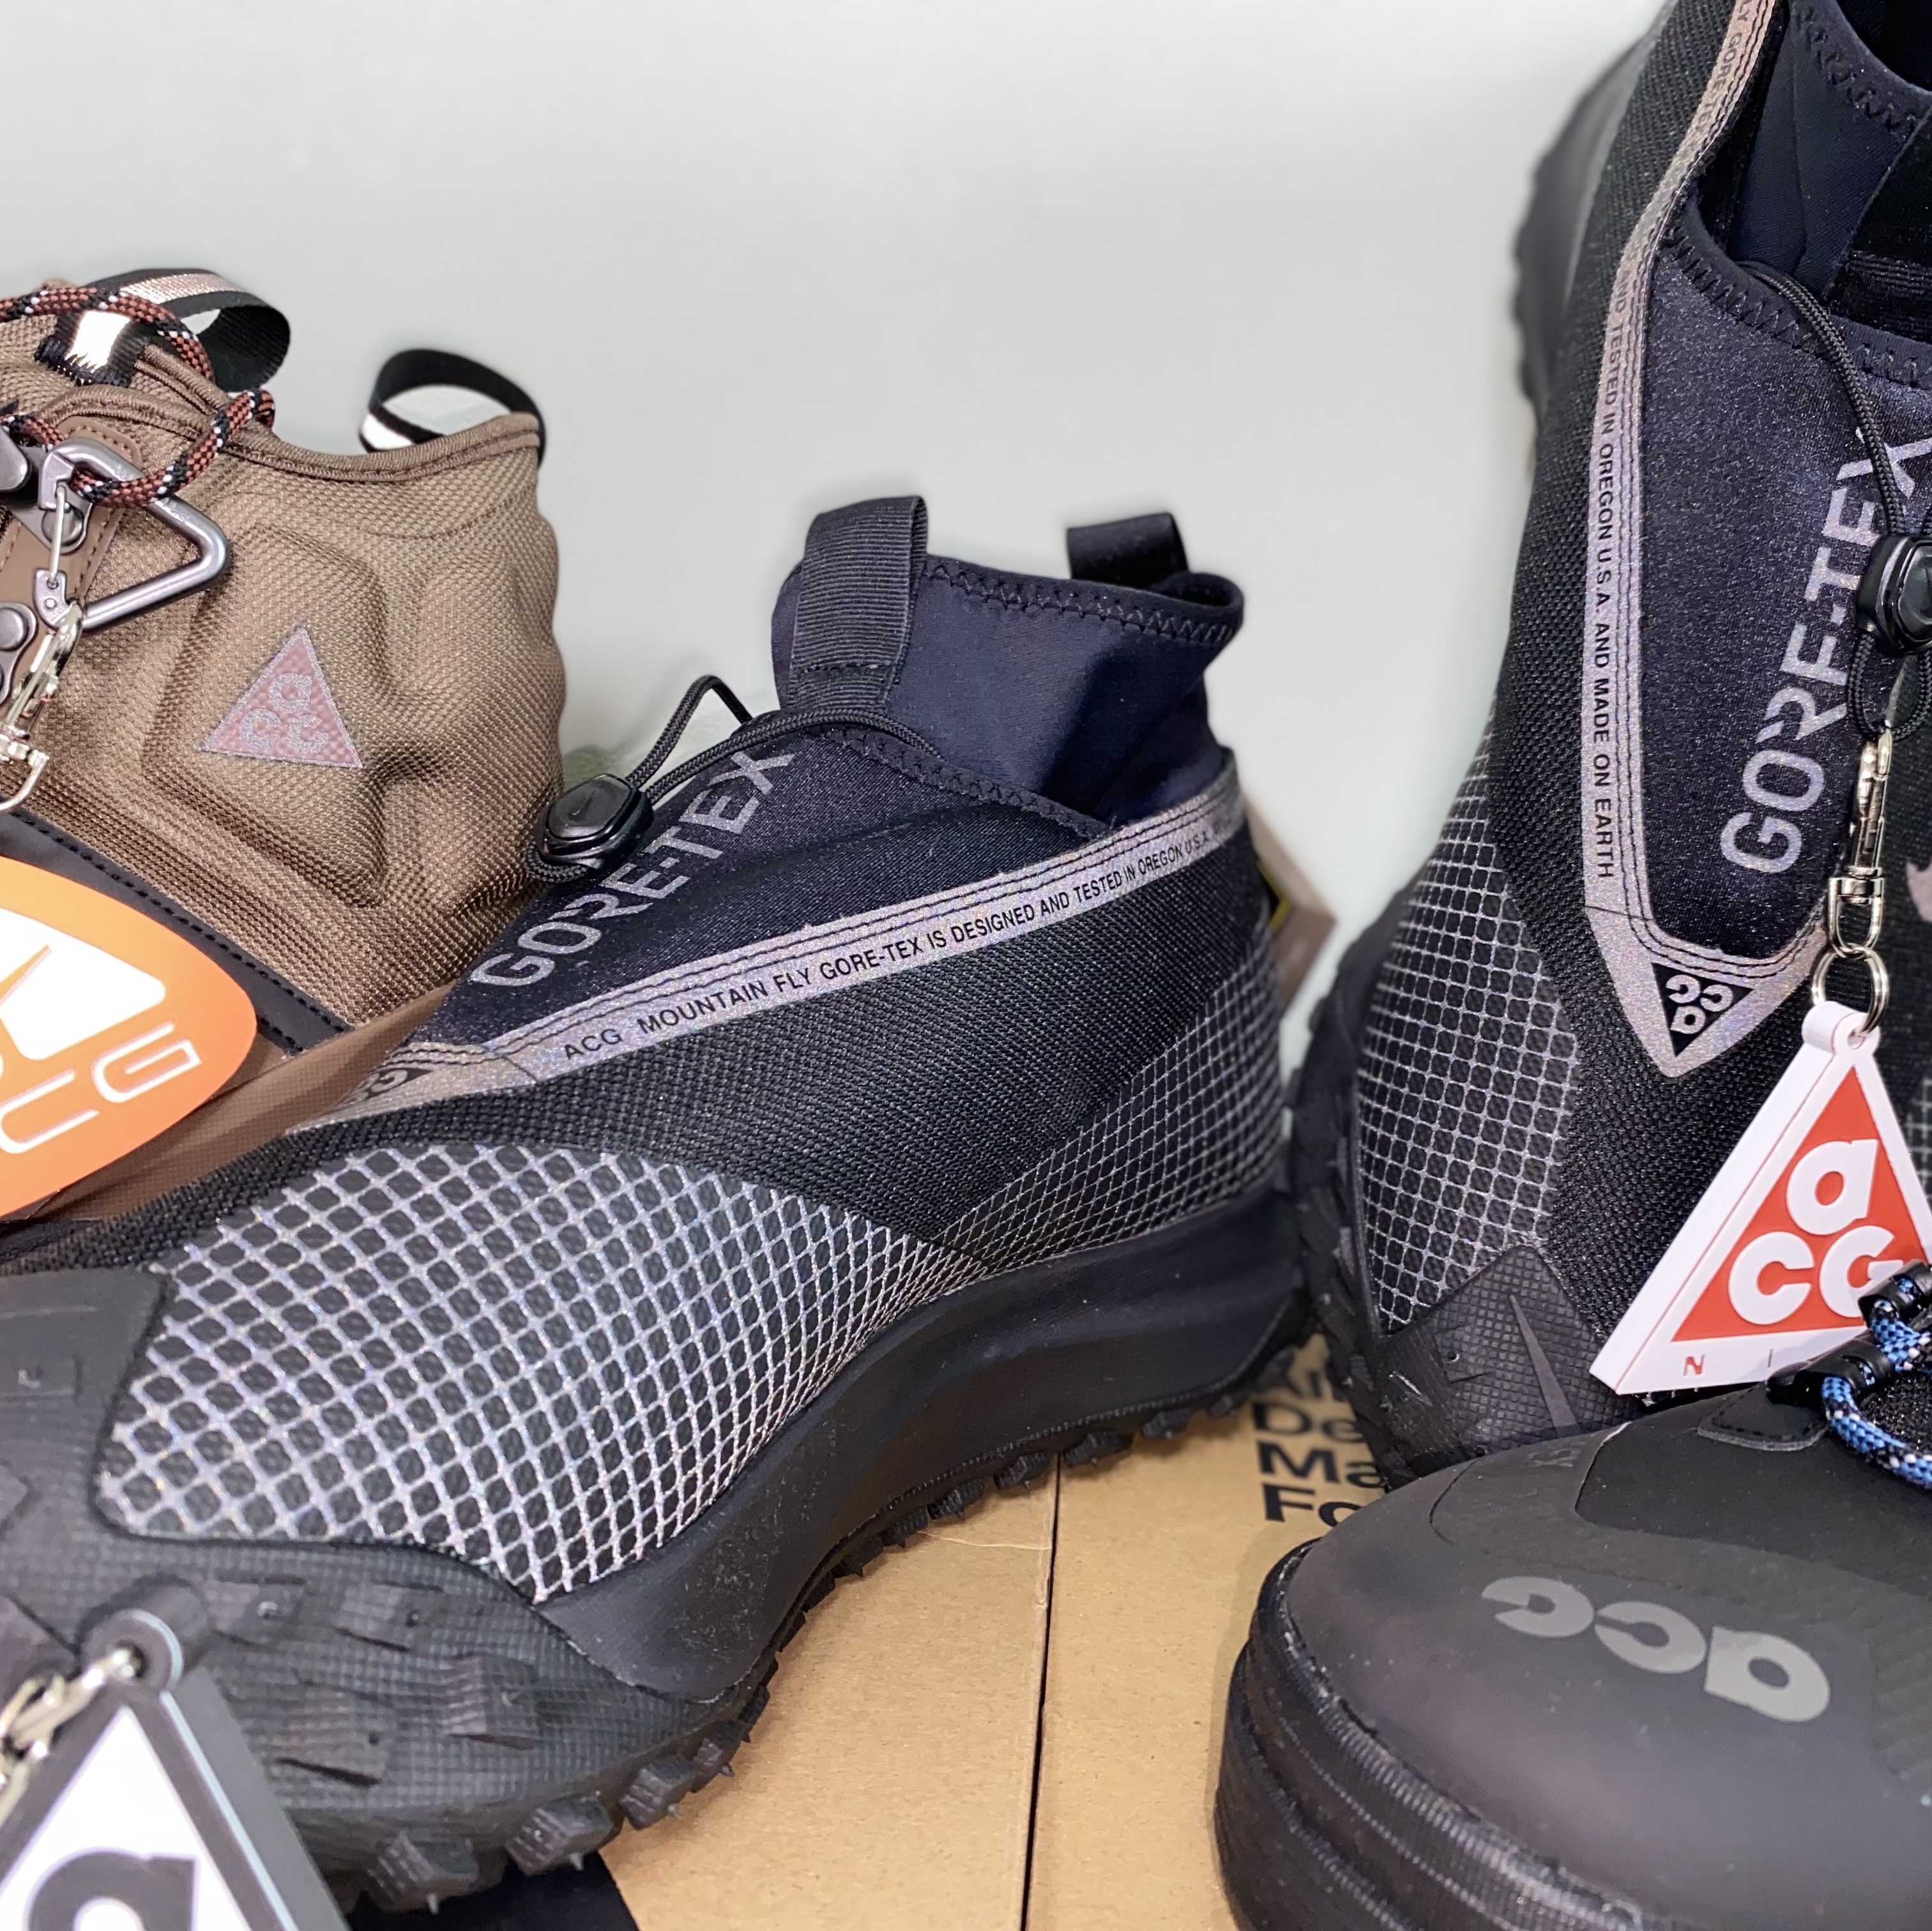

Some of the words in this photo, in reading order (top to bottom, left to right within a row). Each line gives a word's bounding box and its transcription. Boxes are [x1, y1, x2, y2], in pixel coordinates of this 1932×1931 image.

[1605, 322, 1623, 405] TESTED
[1601, 413, 1615, 435] IN
[1599, 443, 1613, 540] OREGON
[1594, 623, 1609, 668] AND
[1594, 678, 1609, 743] MADE
[1594, 754, 1610, 786] ON
[469, 749, 795, 987] GORE-TEX
[1594, 798, 1614, 877] EARTH
[564, 1029, 623, 1060] ACG
[637, 980, 768, 1034] MOUNTAIN
[773, 967, 812, 993] FLY
[820, 937, 924, 980] GORE-TEX
[928, 930, 947, 950] IS
[951, 904, 1035, 943] DESIGNED
[1040, 891, 1070, 916] AND
[1074, 871, 1123, 904] TESTED
[1123, 864, 1135, 883] IN
[1137, 844, 1183, 875] OREGON
